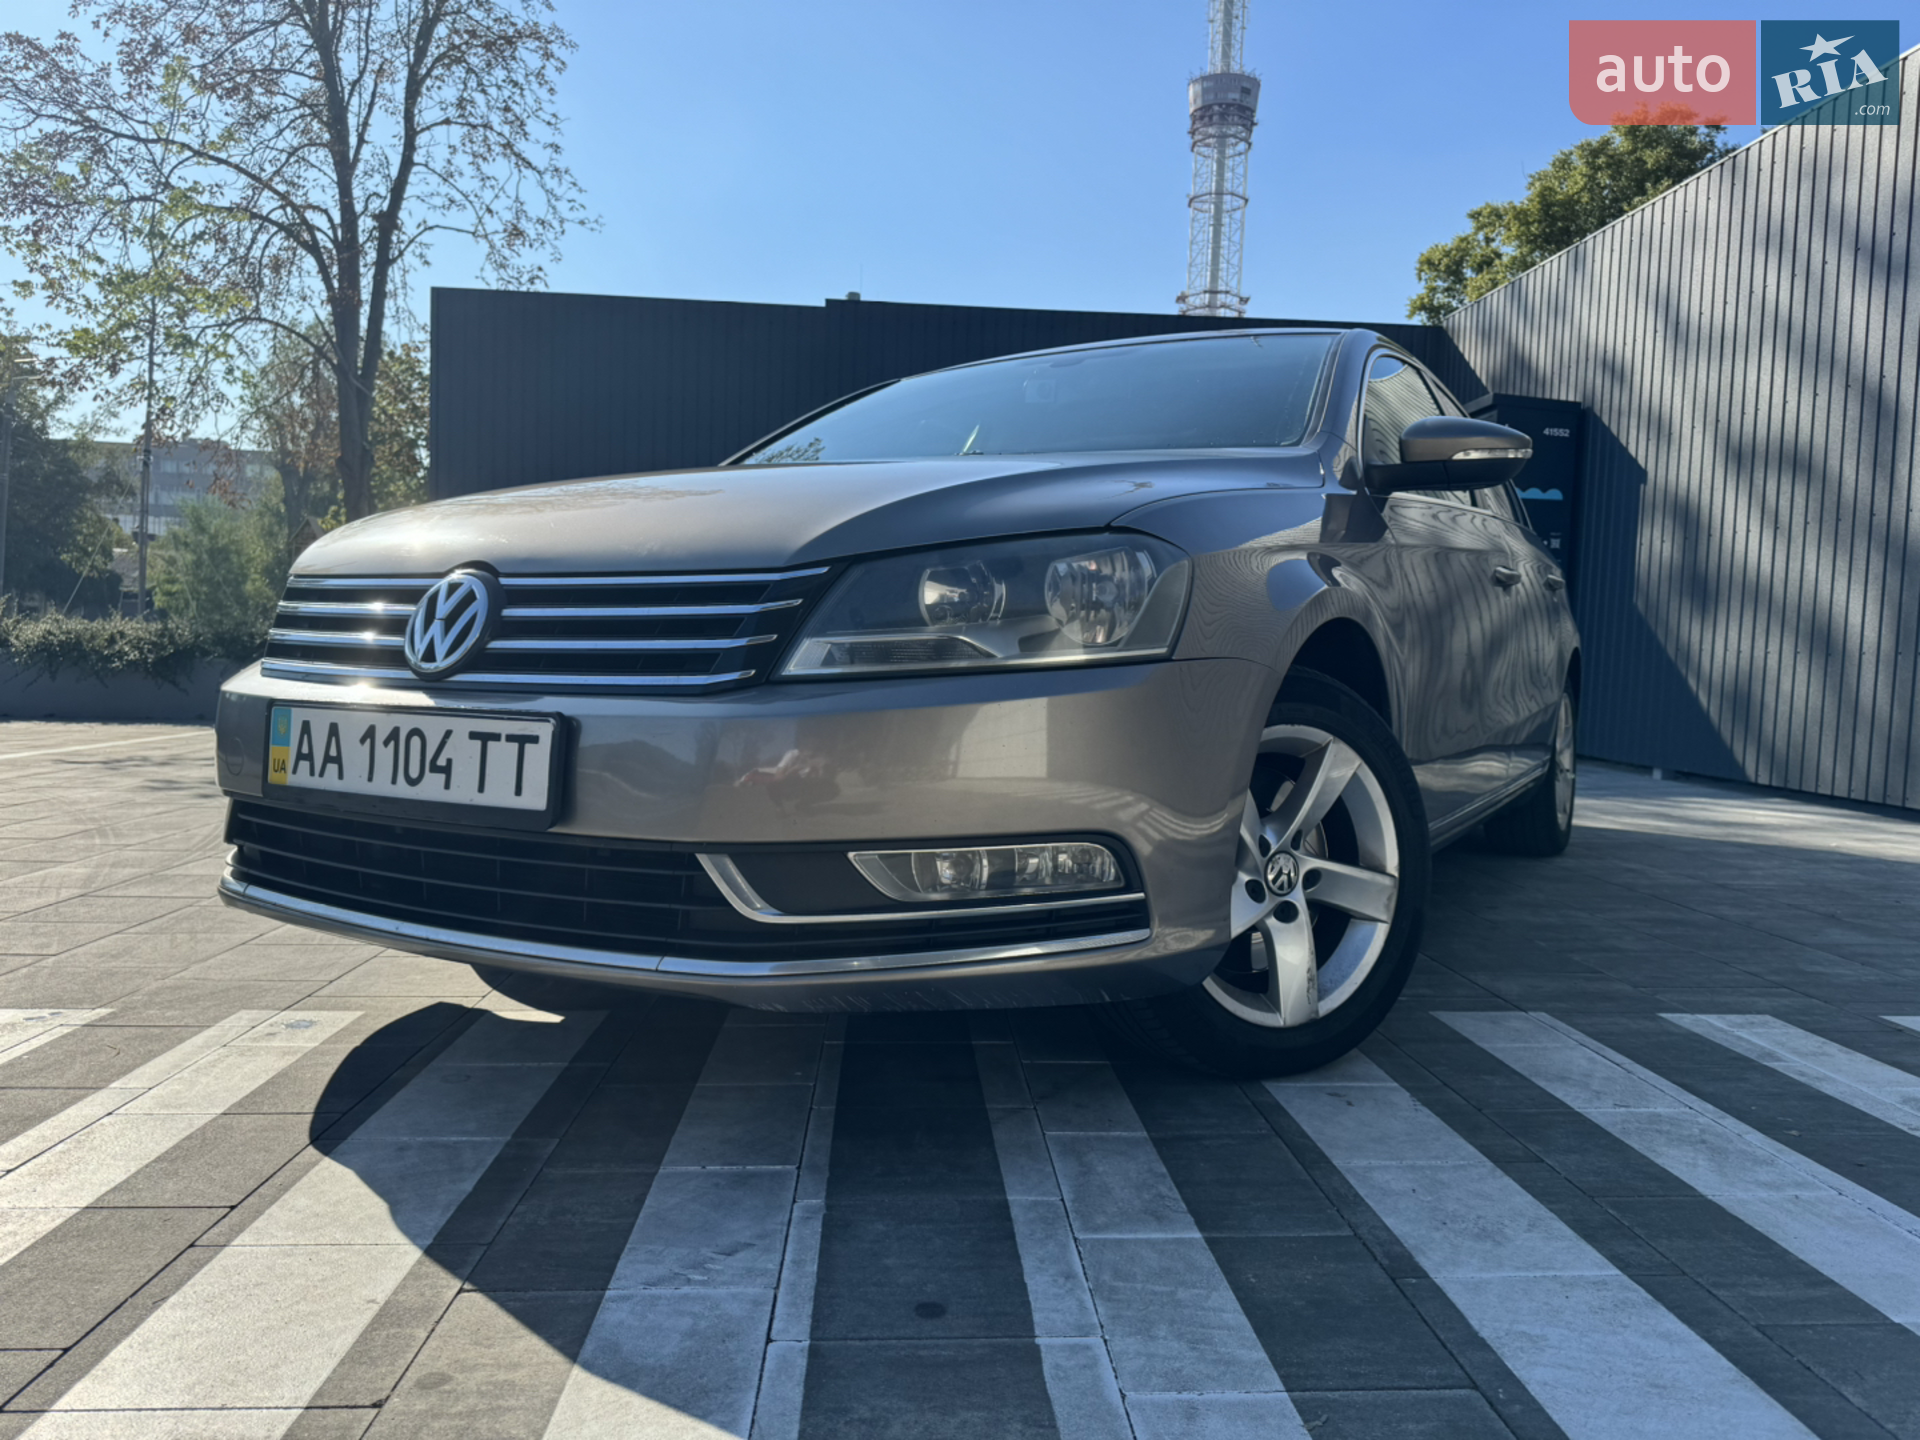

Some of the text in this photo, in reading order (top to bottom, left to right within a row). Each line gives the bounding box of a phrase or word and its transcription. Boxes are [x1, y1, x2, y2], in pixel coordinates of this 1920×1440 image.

[411, 575, 483, 667] VW
[273, 758, 287, 775] UA
[292, 720, 540, 797] AA 1104 TT
